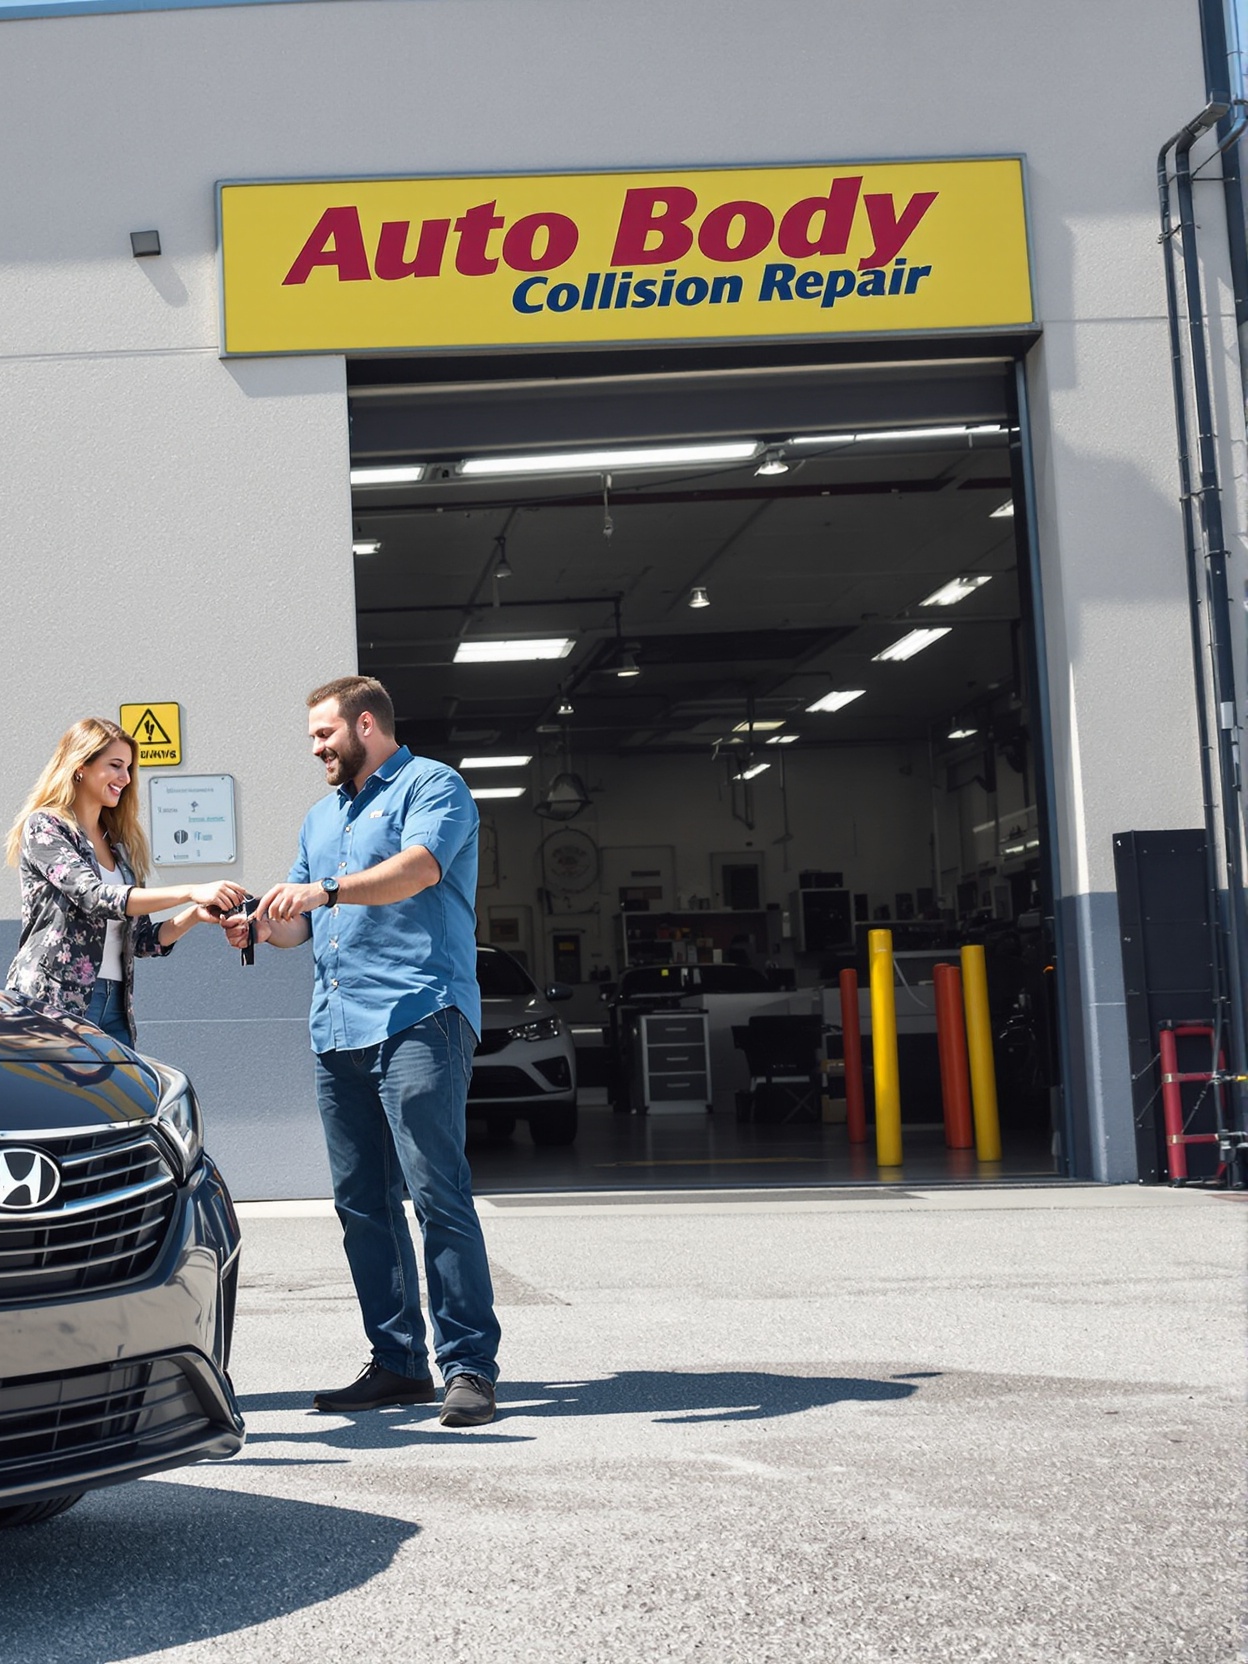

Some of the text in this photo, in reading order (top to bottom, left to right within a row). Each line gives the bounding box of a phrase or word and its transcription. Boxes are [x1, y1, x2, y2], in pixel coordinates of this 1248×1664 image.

[283, 176, 939, 286] Auto Body
[513, 257, 932, 314] Collision Repair
